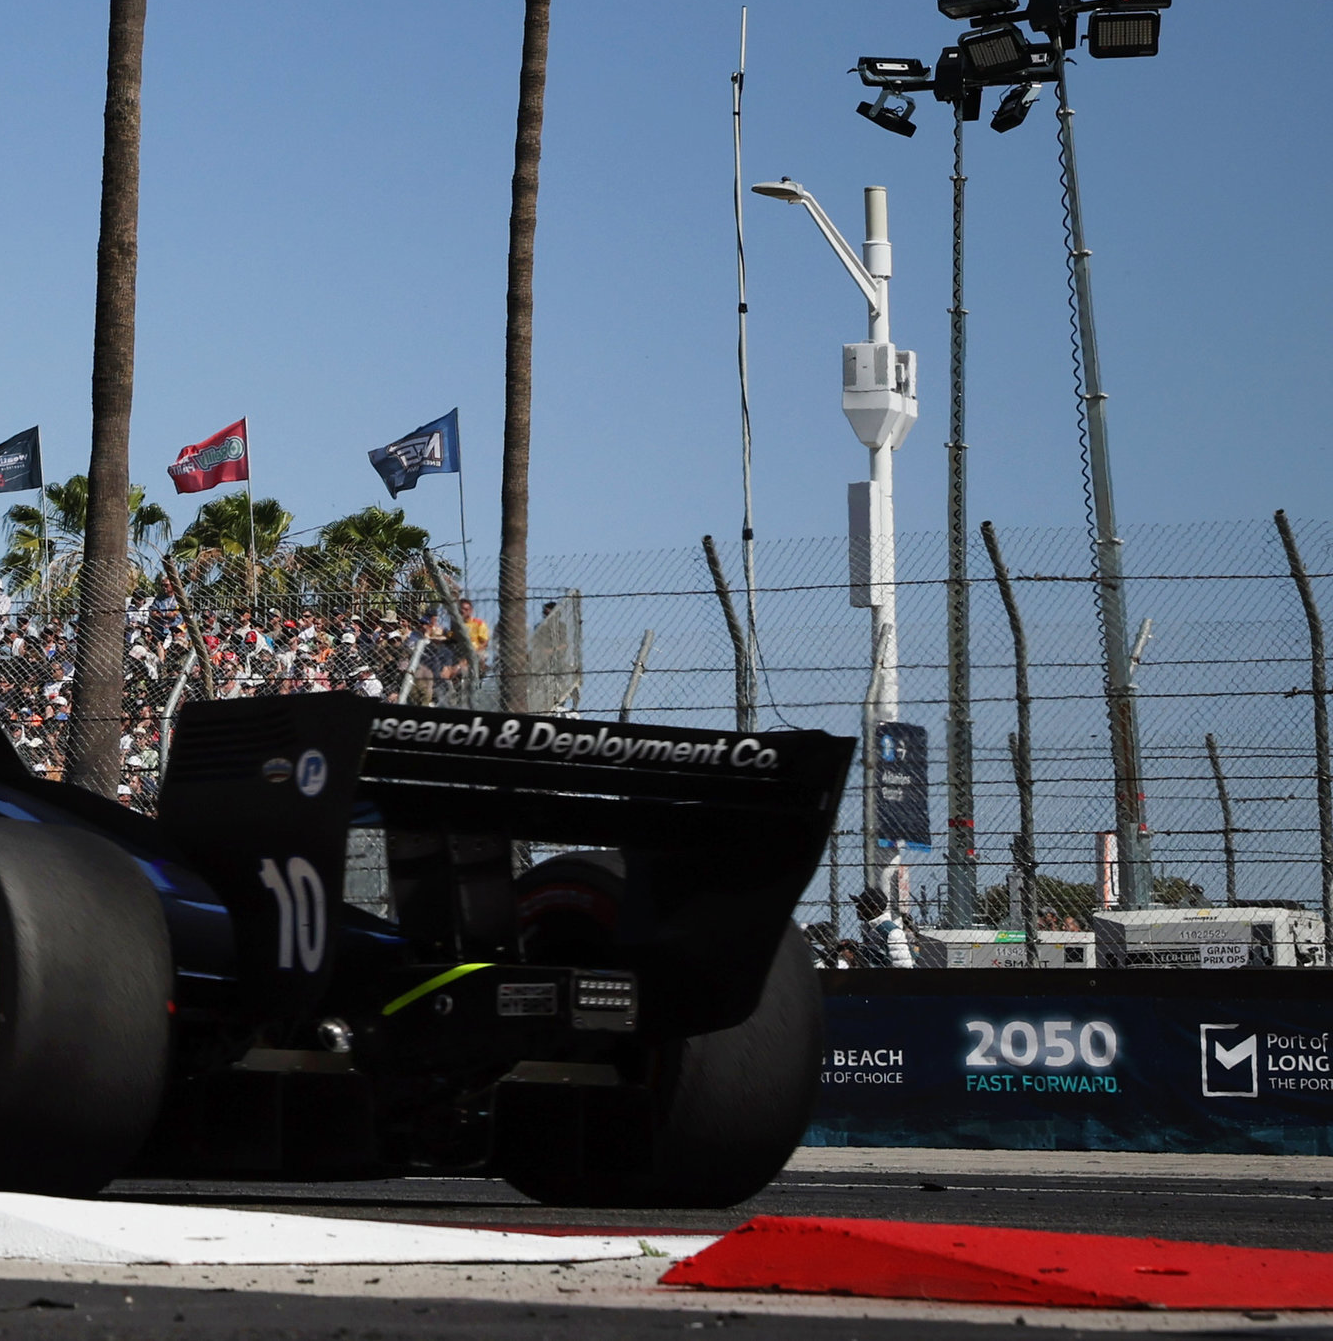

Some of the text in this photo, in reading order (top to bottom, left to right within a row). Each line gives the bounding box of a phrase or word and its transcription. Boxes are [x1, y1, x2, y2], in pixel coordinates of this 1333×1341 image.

[371, 716, 780, 770] search & Deployment Co.
[258, 856, 326, 972] 10
[1203, 955, 1246, 964] PRIX OPS
[1206, 946, 1241, 955] GRAND
[965, 1020, 1117, 1068] 2050
[1267, 1032, 1329, 1053] Port of
[833, 1049, 903, 1066] BEACH
[1268, 1054, 1330, 1072] LONG
[834, 1071, 852, 1083] OF
[854, 1072, 903, 1083] CHOICE
[966, 1075, 1123, 1093] FAST. FORWARD.
[1268, 1077, 1297, 1090] THE
